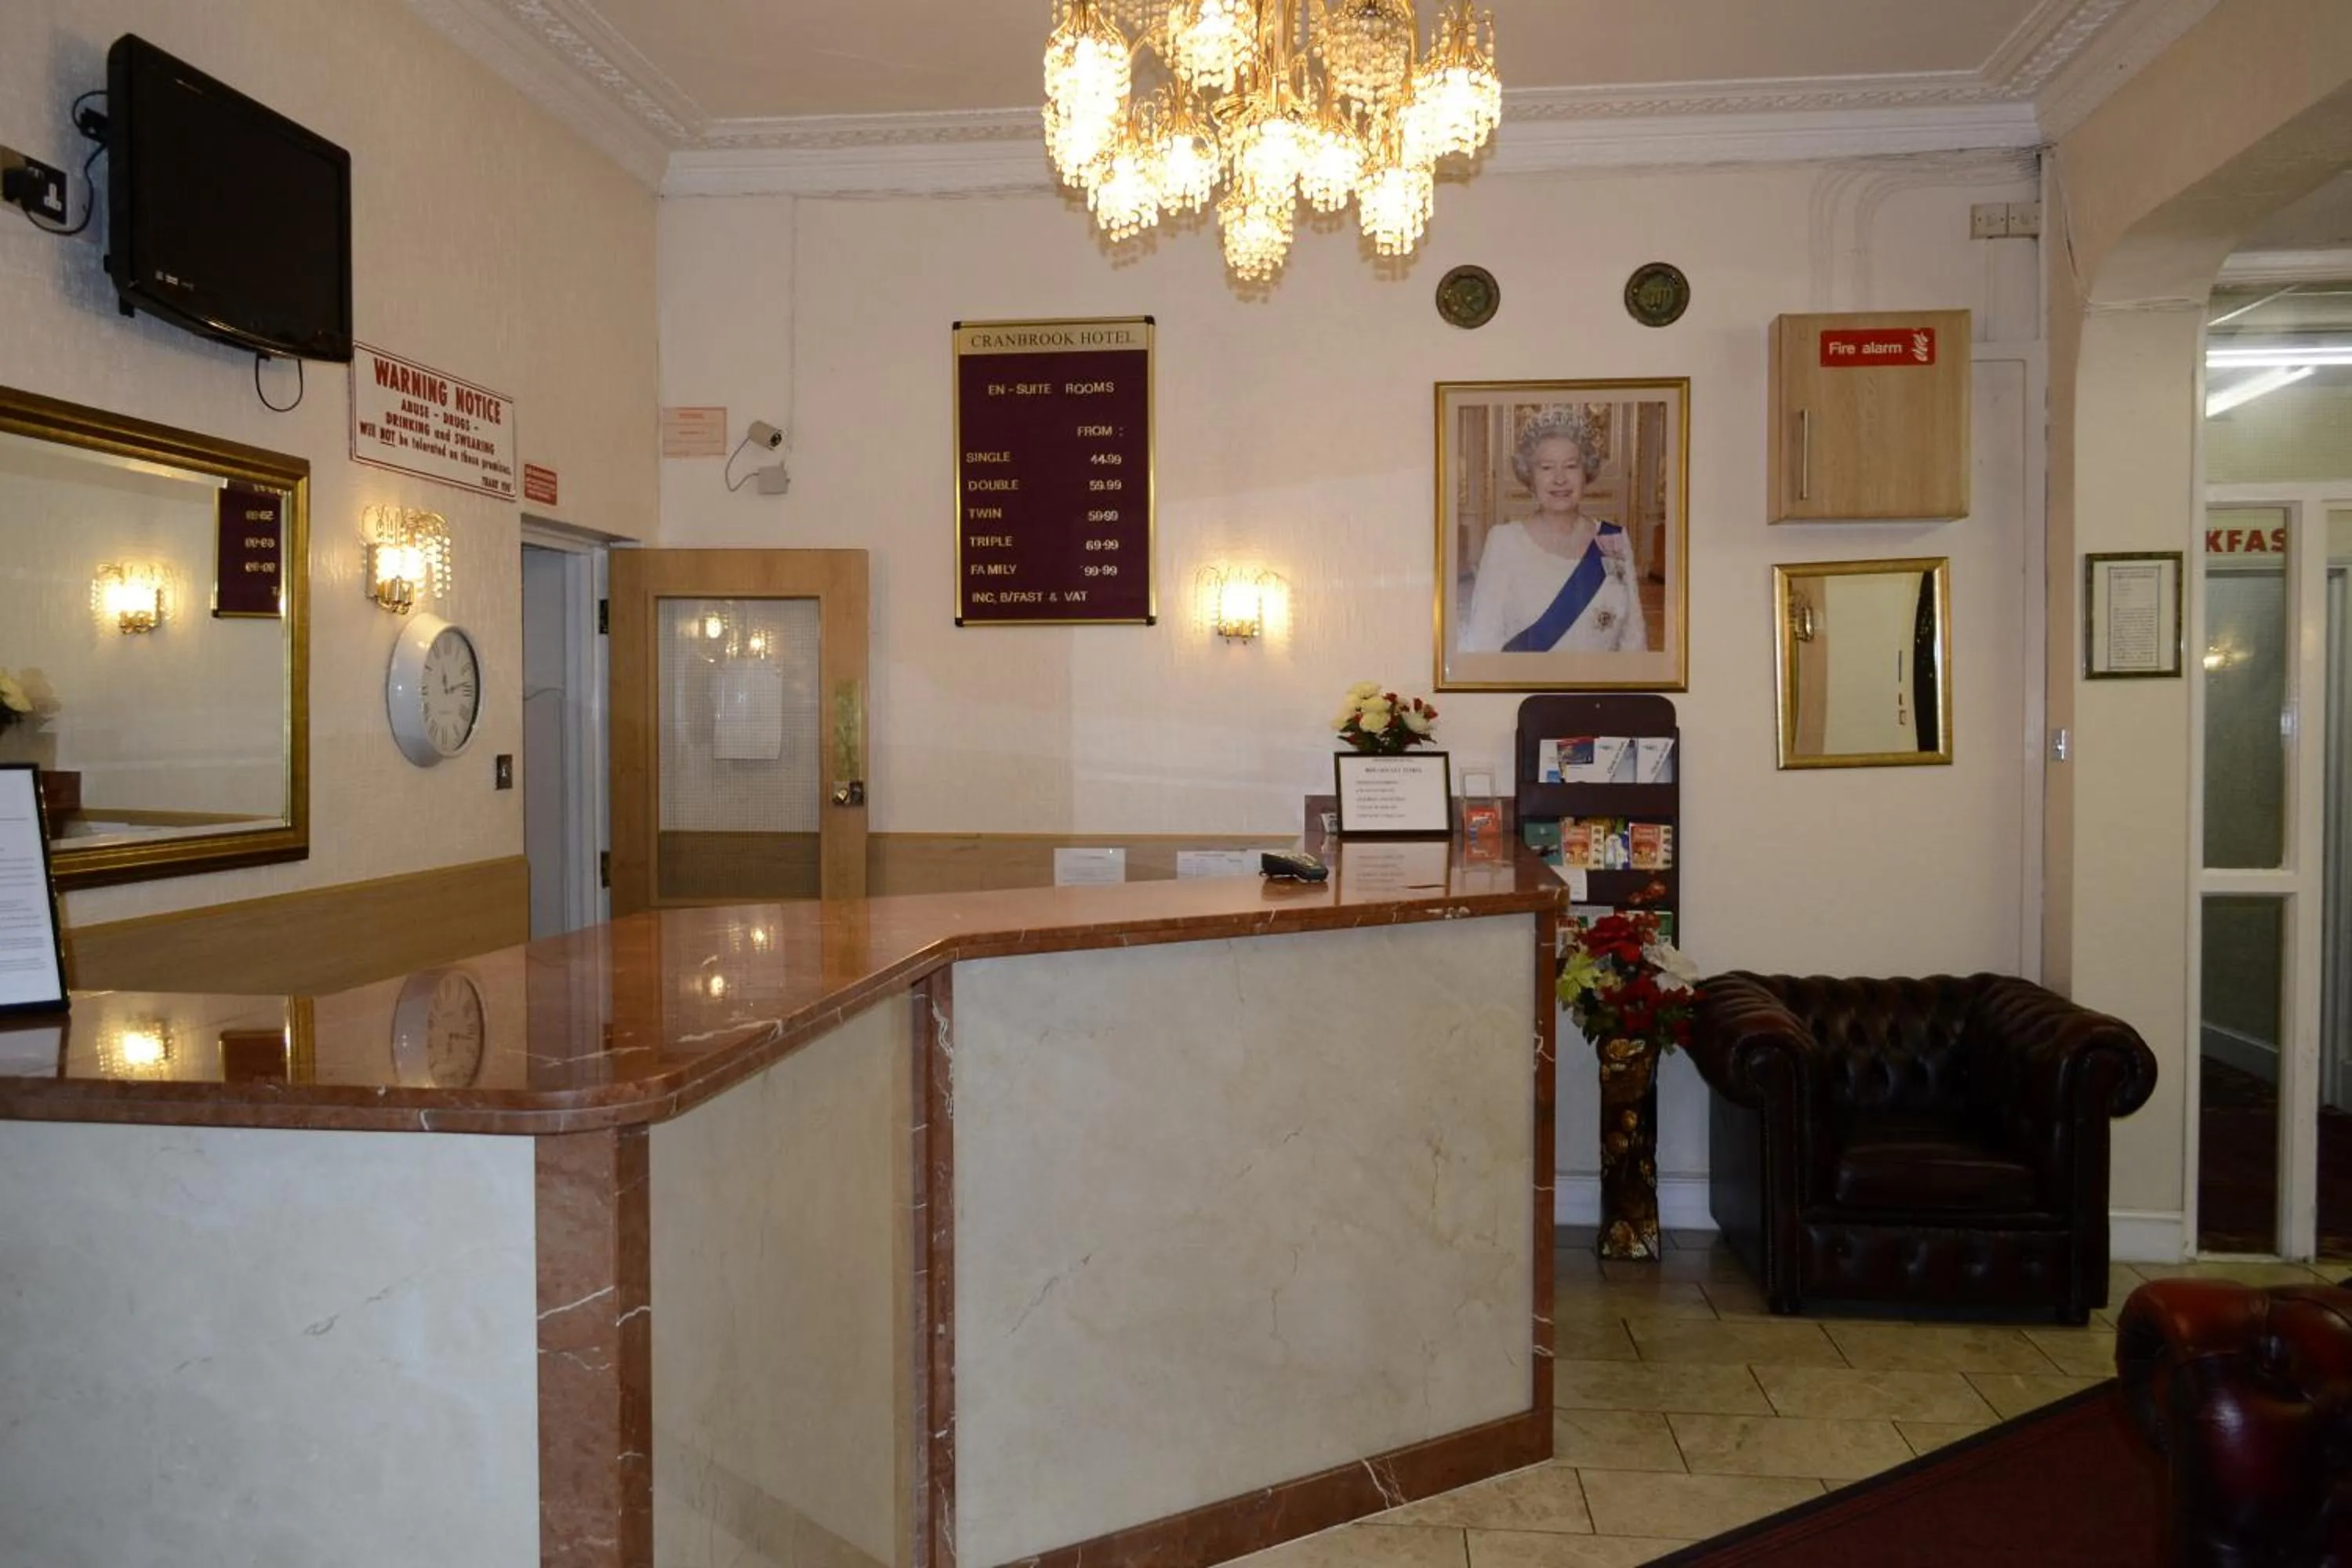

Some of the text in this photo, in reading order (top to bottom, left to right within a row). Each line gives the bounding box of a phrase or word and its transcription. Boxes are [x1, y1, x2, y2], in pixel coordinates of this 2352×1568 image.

[971, 330, 1134, 348] CRANBROOK HOTEL
[1829, 342, 1902, 355] Fire alarm
[373, 358, 501, 425] WARNING NOTICE
[1065, 382, 1114, 394] ROOMS
[401, 399, 429, 419] ABUSE
[443, 413, 470, 431] DRUGS
[379, 427, 396, 442] NOT
[399, 435, 408, 446] be
[386, 412, 495, 455] DRINKING and SWEARING
[1077, 426, 1112, 437] FROM
[966, 452, 1011, 463] SINGLE
[968, 480, 1019, 492] DOUBLE
[968, 508, 1002, 519] TWIN
[970, 536, 1013, 547] TRIPLE
[971, 564, 1016, 575] FAMILY
[1000, 591, 1042, 603] B/FAST
[1065, 591, 1087, 602] VAT
